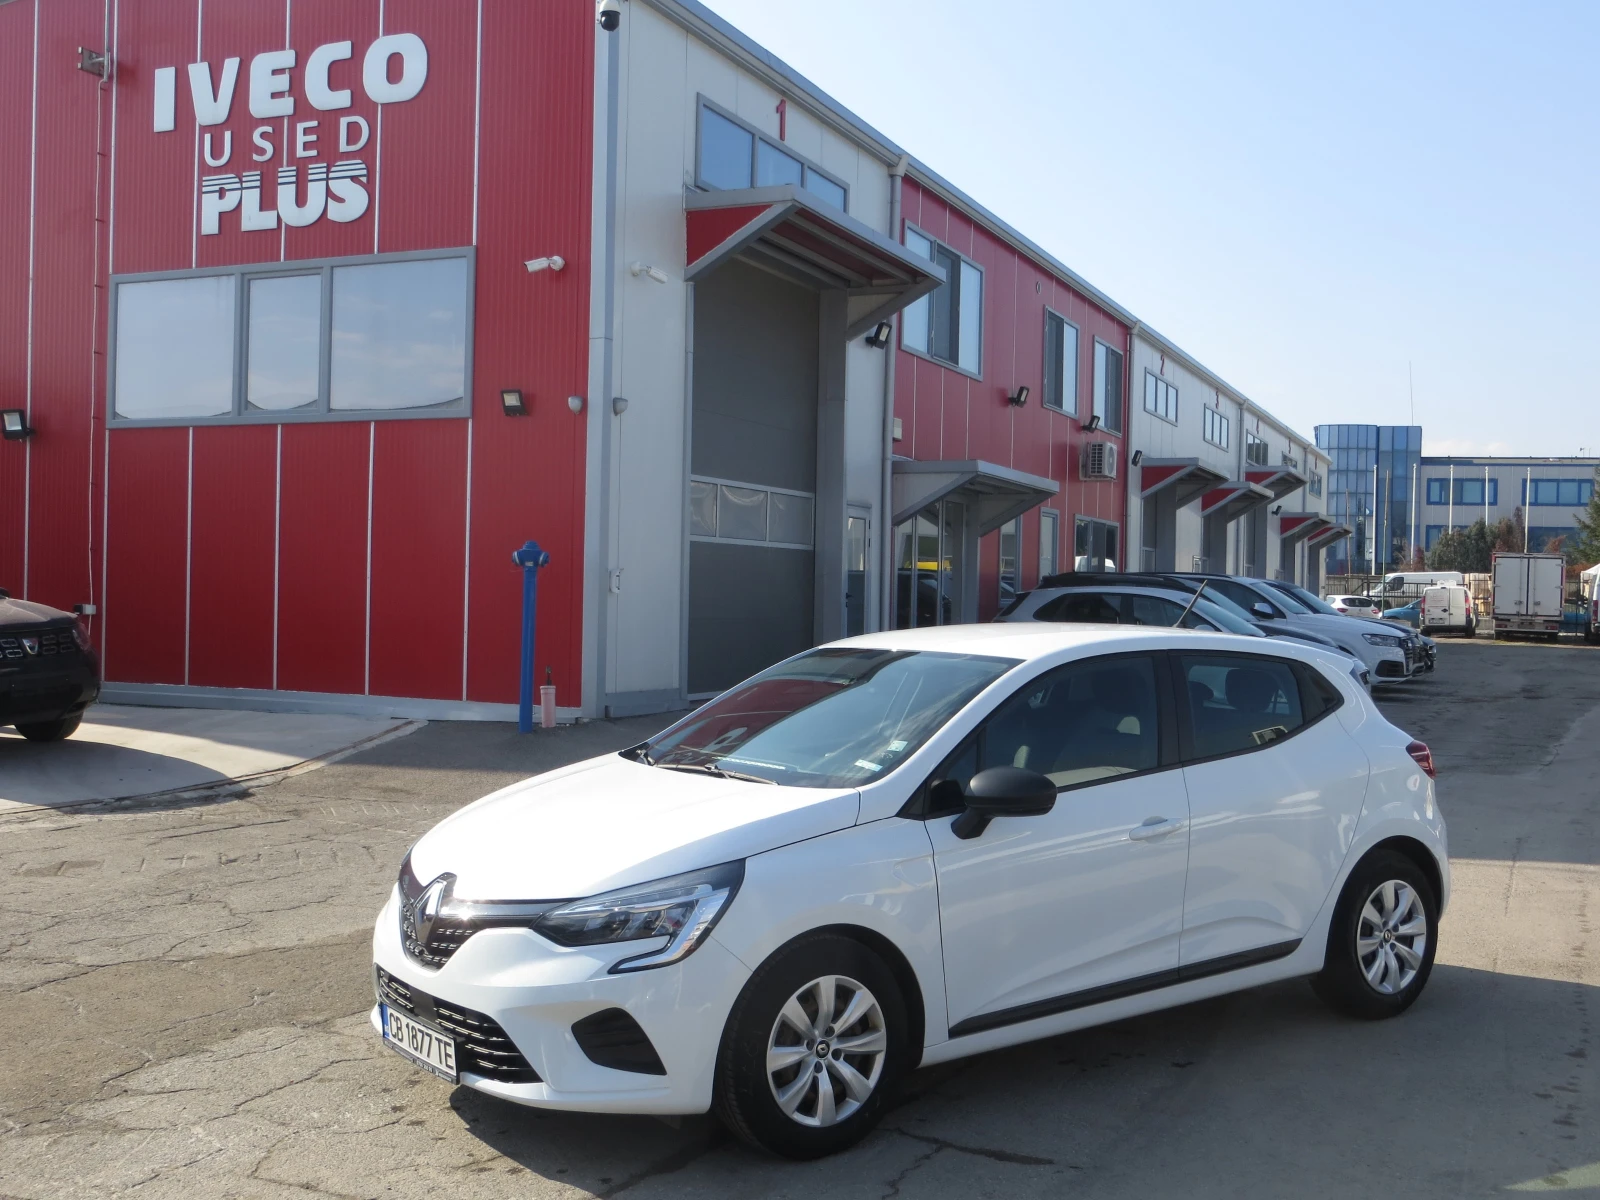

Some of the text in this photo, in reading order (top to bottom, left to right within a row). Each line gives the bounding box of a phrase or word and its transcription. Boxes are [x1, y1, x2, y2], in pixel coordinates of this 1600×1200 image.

[153, 32, 428, 133] IVECO
[203, 115, 370, 168] USED
[776, 98, 786, 141] 1
[200, 159, 370, 236] PLUS
[1160, 354, 1165, 376] 2
[405, 1022, 433, 1058] 1877
[434, 1036, 455, 1070] TE
